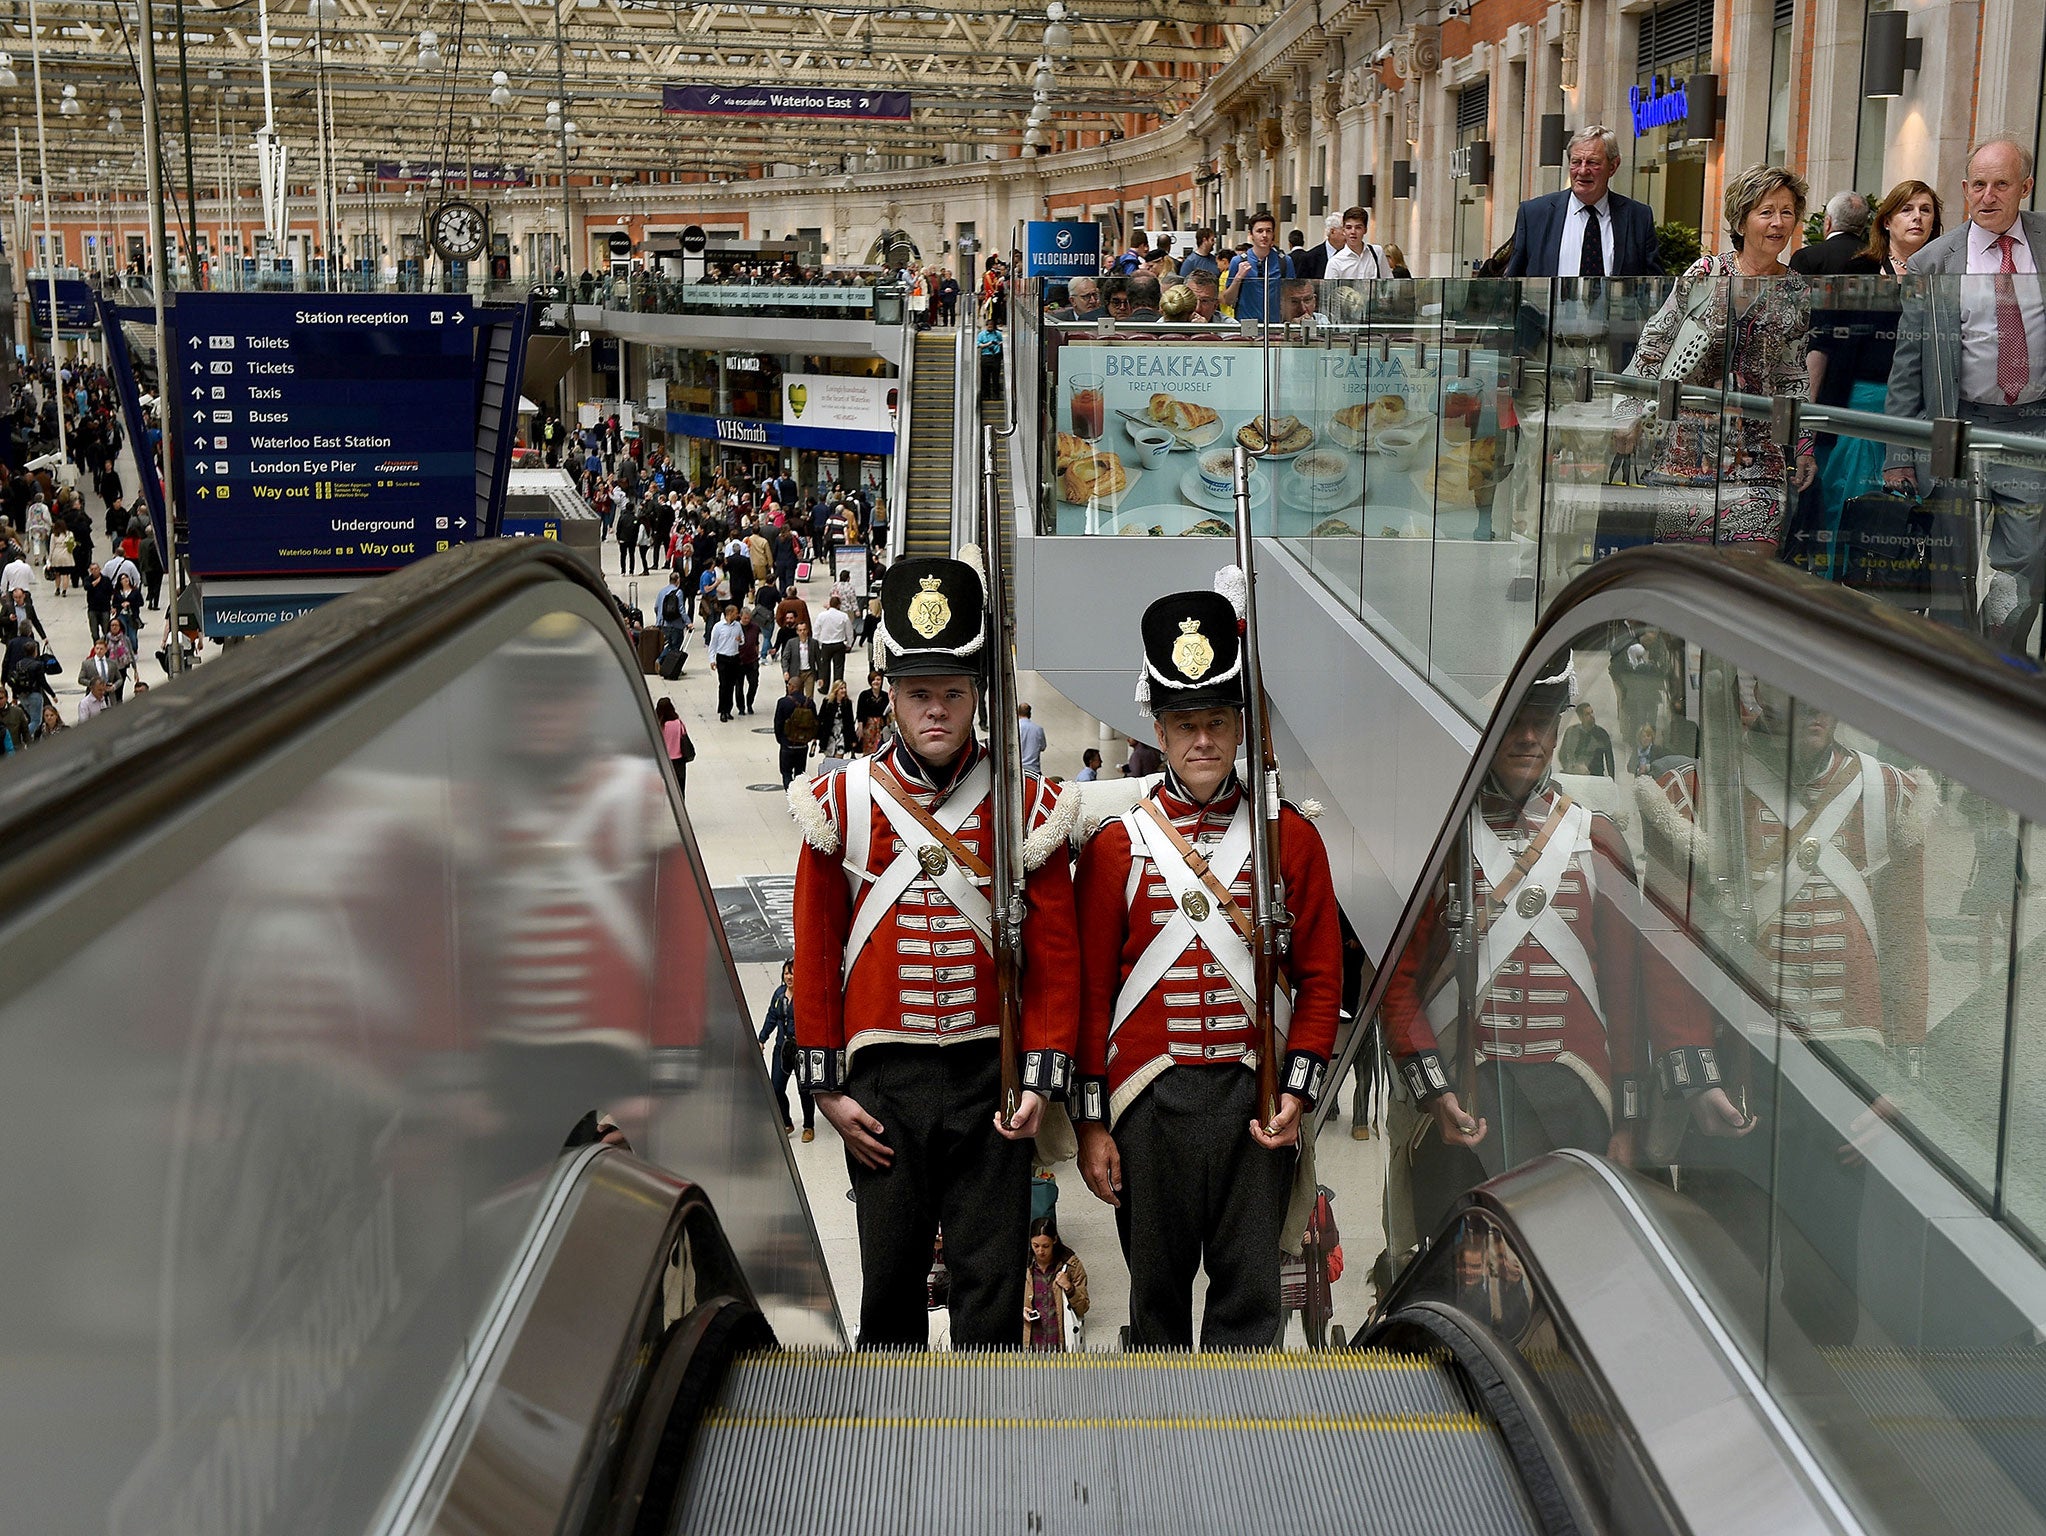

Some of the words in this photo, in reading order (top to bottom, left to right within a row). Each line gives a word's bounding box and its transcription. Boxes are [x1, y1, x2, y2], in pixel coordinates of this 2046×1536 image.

[770, 95, 824, 107] Waterloo
[826, 96, 852, 108] East
[1032, 253, 1096, 265] VELOCIRAPTOR
[295, 311, 344, 324] Station
[347, 312, 409, 326] reception
[246, 337, 290, 349] Toilets
[247, 361, 295, 374] Tickets
[1106, 354, 1236, 377] BREAKFAST
[248, 386, 282, 399] Taxis
[1128, 381, 1157, 392] TREAT
[1161, 381, 1212, 392] YOURSELF
[249, 411, 289, 423] Buses
[716, 420, 767, 443] WHSmith
[251, 436, 310, 448] Waterloo
[313, 436, 341, 448] East
[344, 436, 391, 448] Station
[250, 461, 300, 473] London
[303, 461, 328, 475] Eye
[331, 460, 357, 472] Pier
[374, 464, 419, 473] clippers
[253, 485, 281, 500] Way
[286, 486, 310, 497] out
[331, 518, 415, 532] Underground
[547, 531, 555, 540] 7
[313, 547, 331, 556] Road
[360, 542, 389, 557] Way
[391, 542, 415, 554] out
[215, 609, 276, 624] Welcome
[280, 610, 294, 622] to
